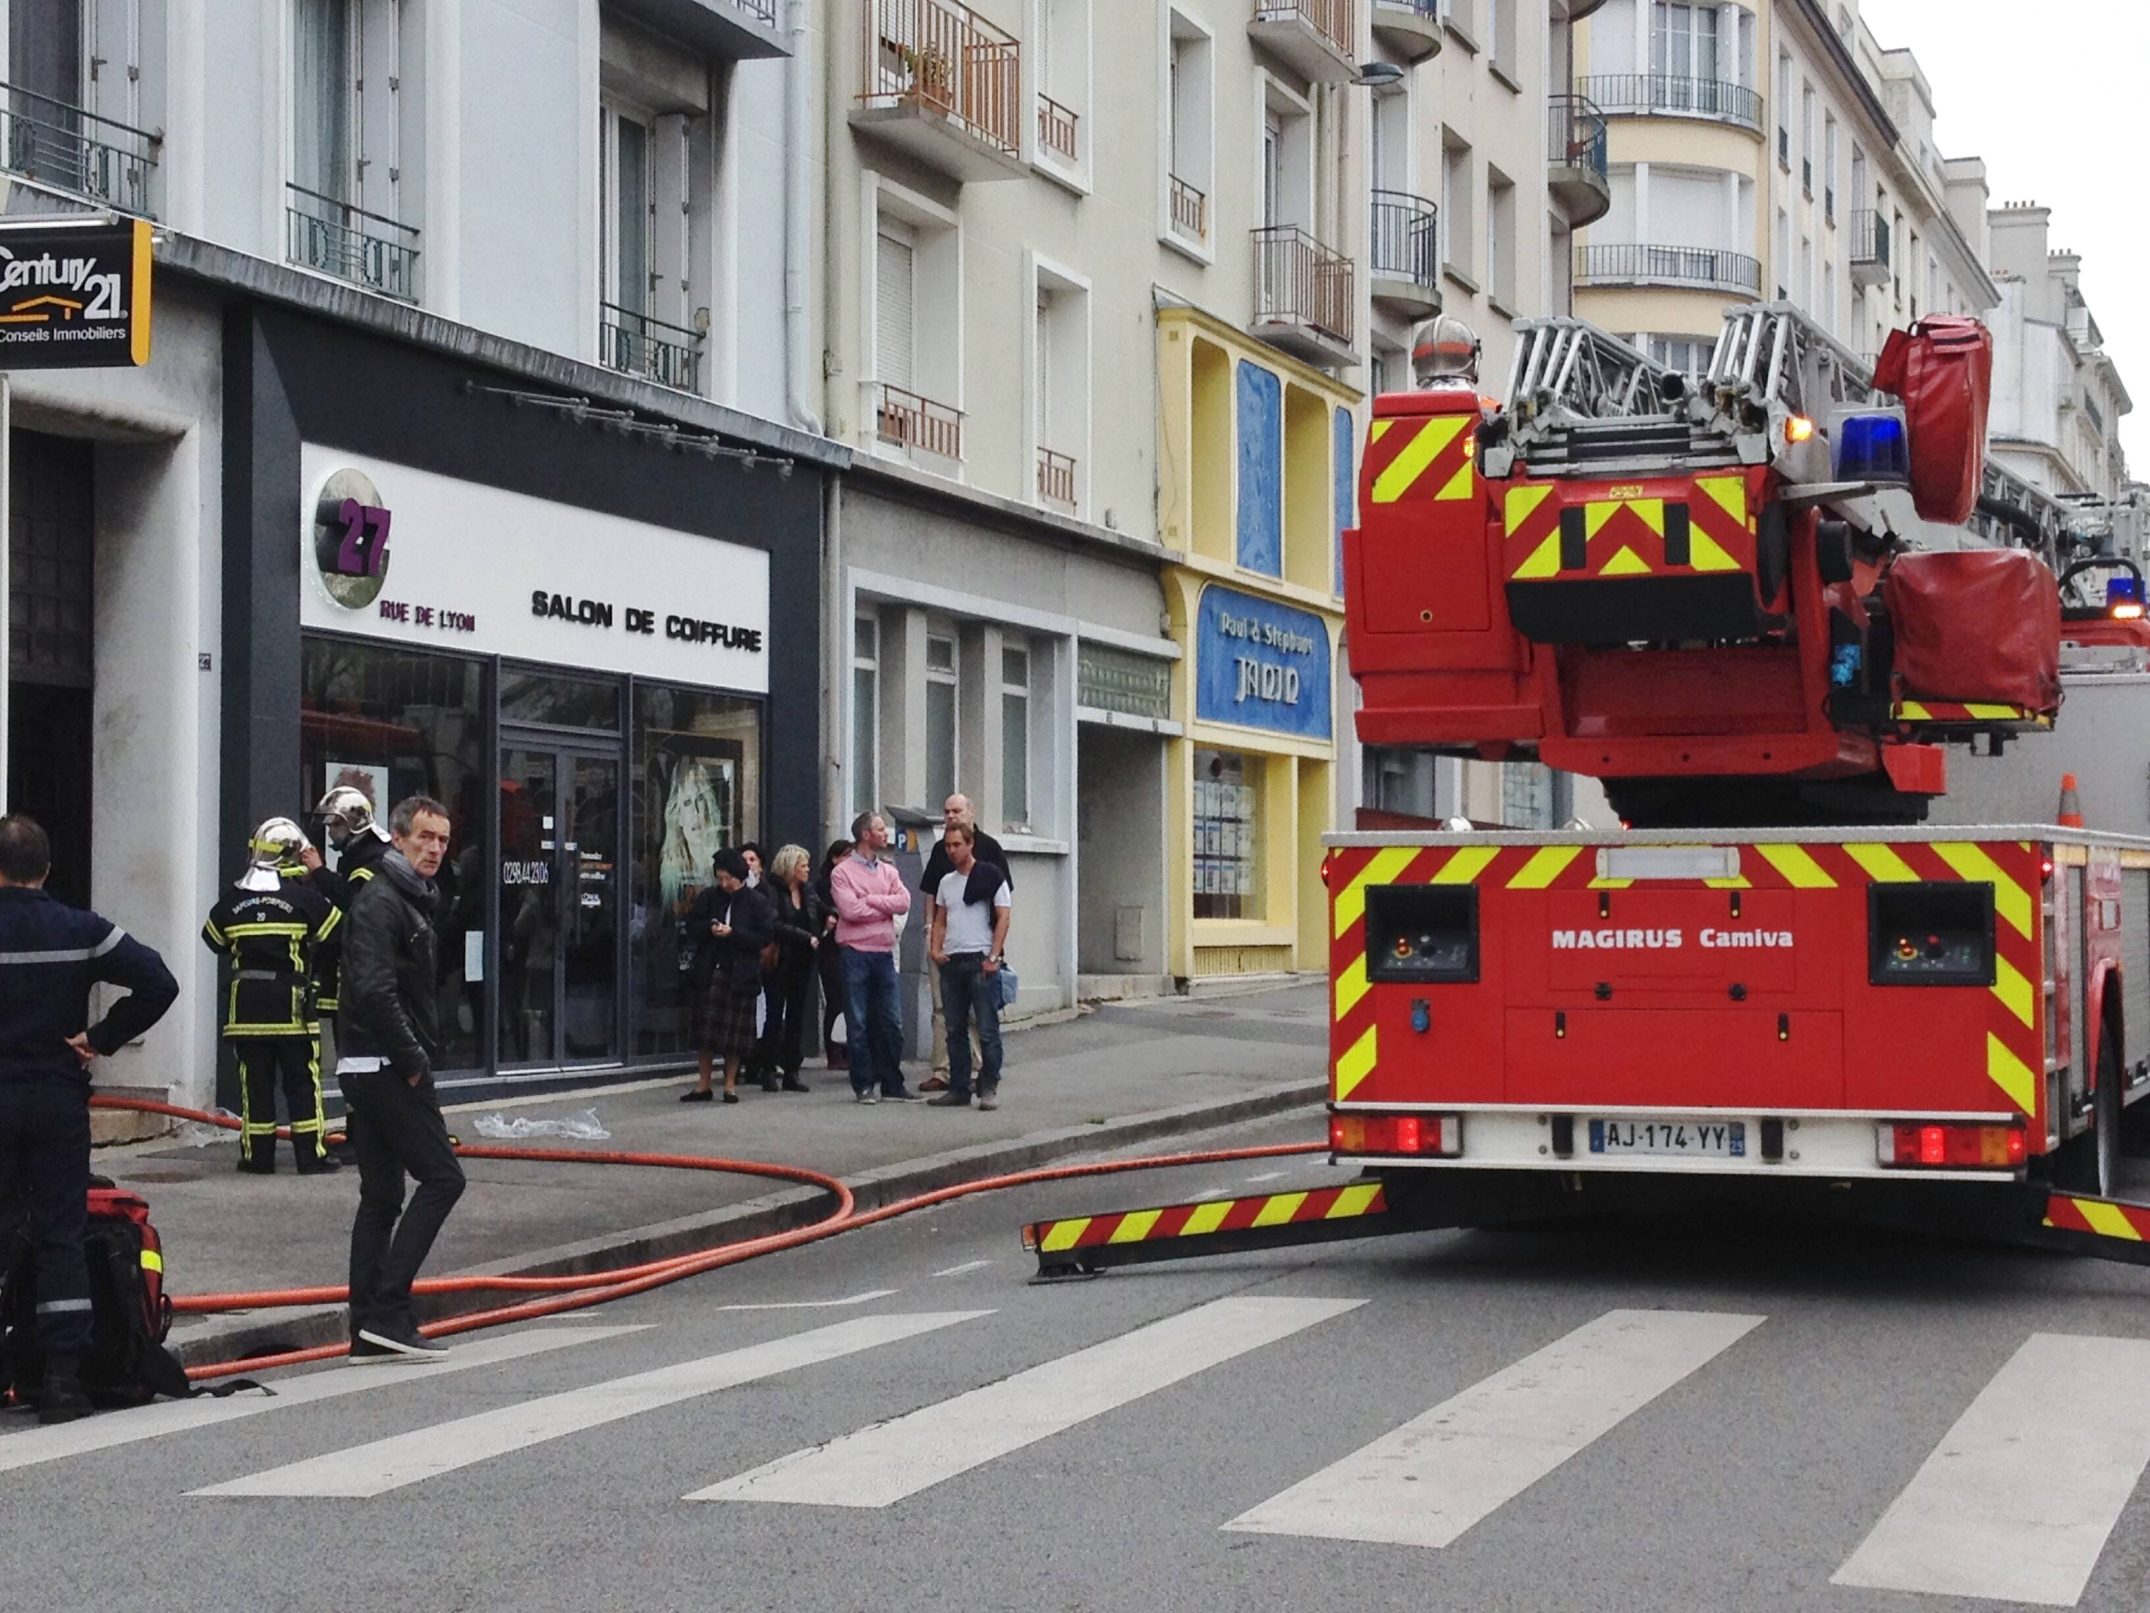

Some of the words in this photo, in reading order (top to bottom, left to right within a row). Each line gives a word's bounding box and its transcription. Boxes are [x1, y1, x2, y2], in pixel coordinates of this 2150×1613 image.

[83, 273, 121, 320] 21
[0, 327, 50, 342] Conseils
[53, 326, 126, 341] Immobiliers
[337, 497, 391, 577] 27
[380, 600, 410, 622] RUE
[415, 605, 435, 627] DE
[439, 609, 475, 632] LYON
[532, 589, 613, 628] SALON
[625, 607, 655, 635] DE
[666, 614, 762, 653] COIFFURE
[1221, 611, 1248, 639] Paul
[897, 833, 907, 849] P
[1552, 928, 1682, 949] MAGIRUS
[1699, 928, 1794, 948] Camiva
